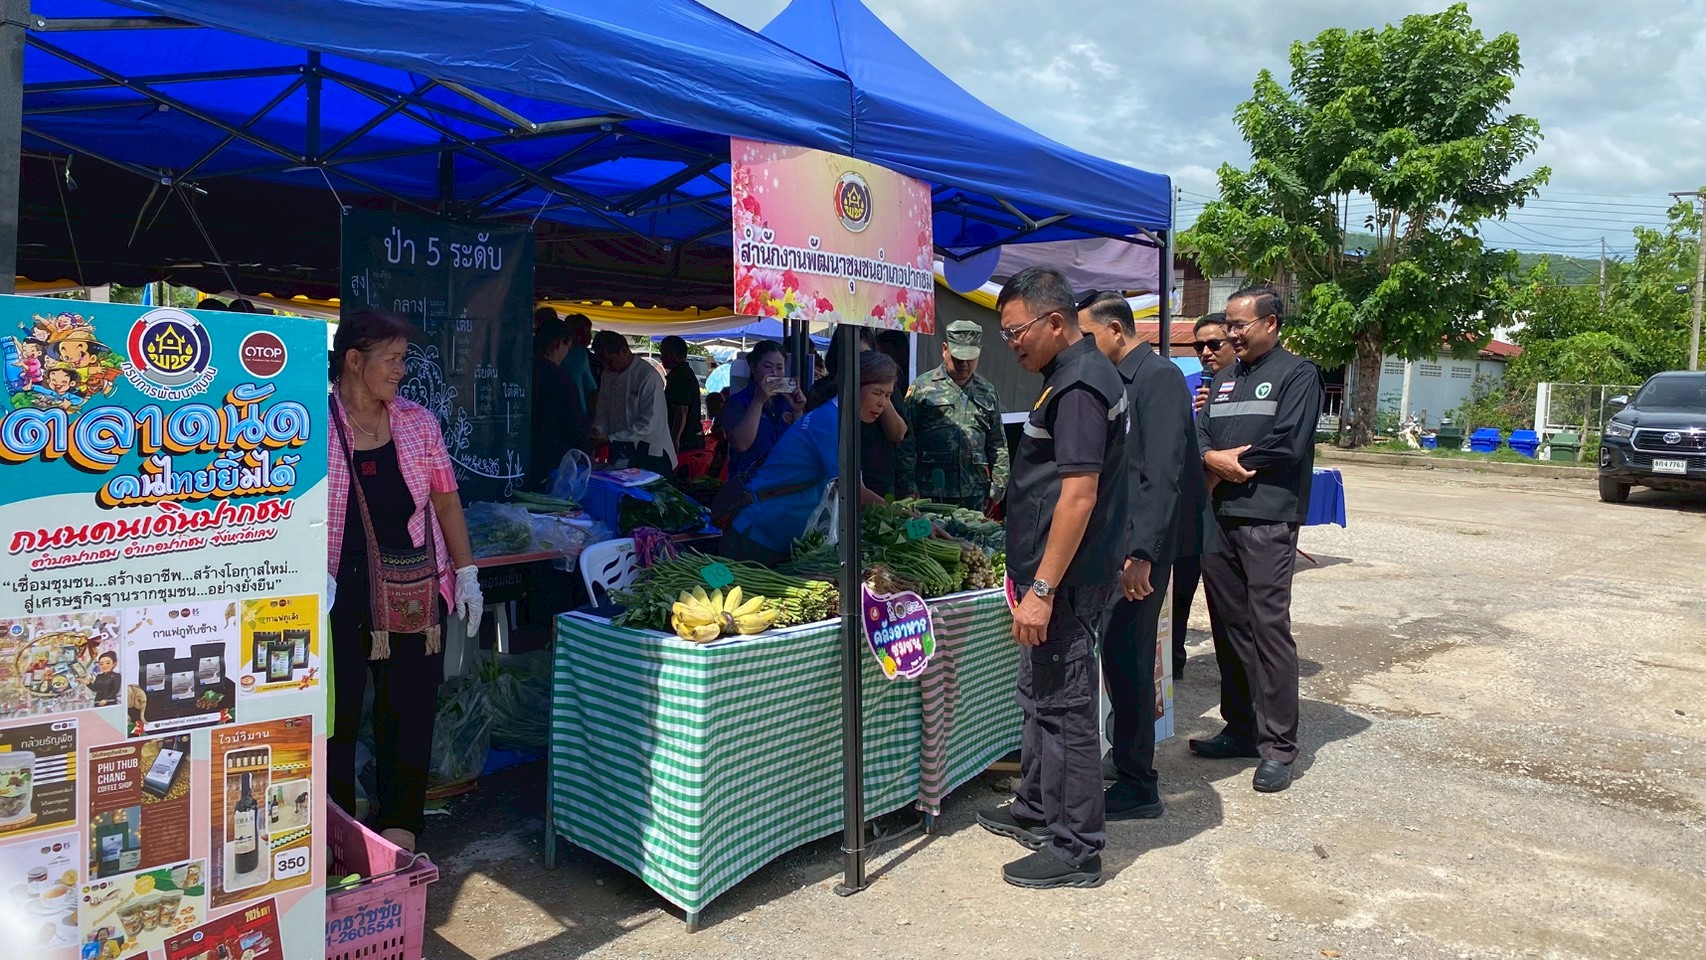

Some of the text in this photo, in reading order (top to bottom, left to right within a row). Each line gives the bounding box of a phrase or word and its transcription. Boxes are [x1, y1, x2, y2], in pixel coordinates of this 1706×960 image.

[384, 226, 502, 271] ป่า 5 ระดับ
[741, 228, 931, 291] สำนักงานพัฒนาชุมชนอำเภอปากชม
[351, 275, 366, 296] สูง
[394, 298, 423, 313] กลาง
[245, 346, 282, 359] OTOP
[122, 363, 217, 400] กรมการพัฒนาชุมชน
[1, 382, 311, 466] ตลาดนัด
[103, 450, 301, 500] คนไทยยิ้มได้
[9, 499, 293, 553] ถนนคนเดินปากชม
[873, 618, 927, 646] คลังอาหาร
[891, 637, 922, 666] ชุมชน
[219, 730, 270, 745] ไวน์วิมาน
[97, 758, 139, 774] PHU THUB
[97, 771, 126, 785] CHANG
[97, 781, 133, 794] COFFEE SHOP
[278, 855, 306, 872] 350
